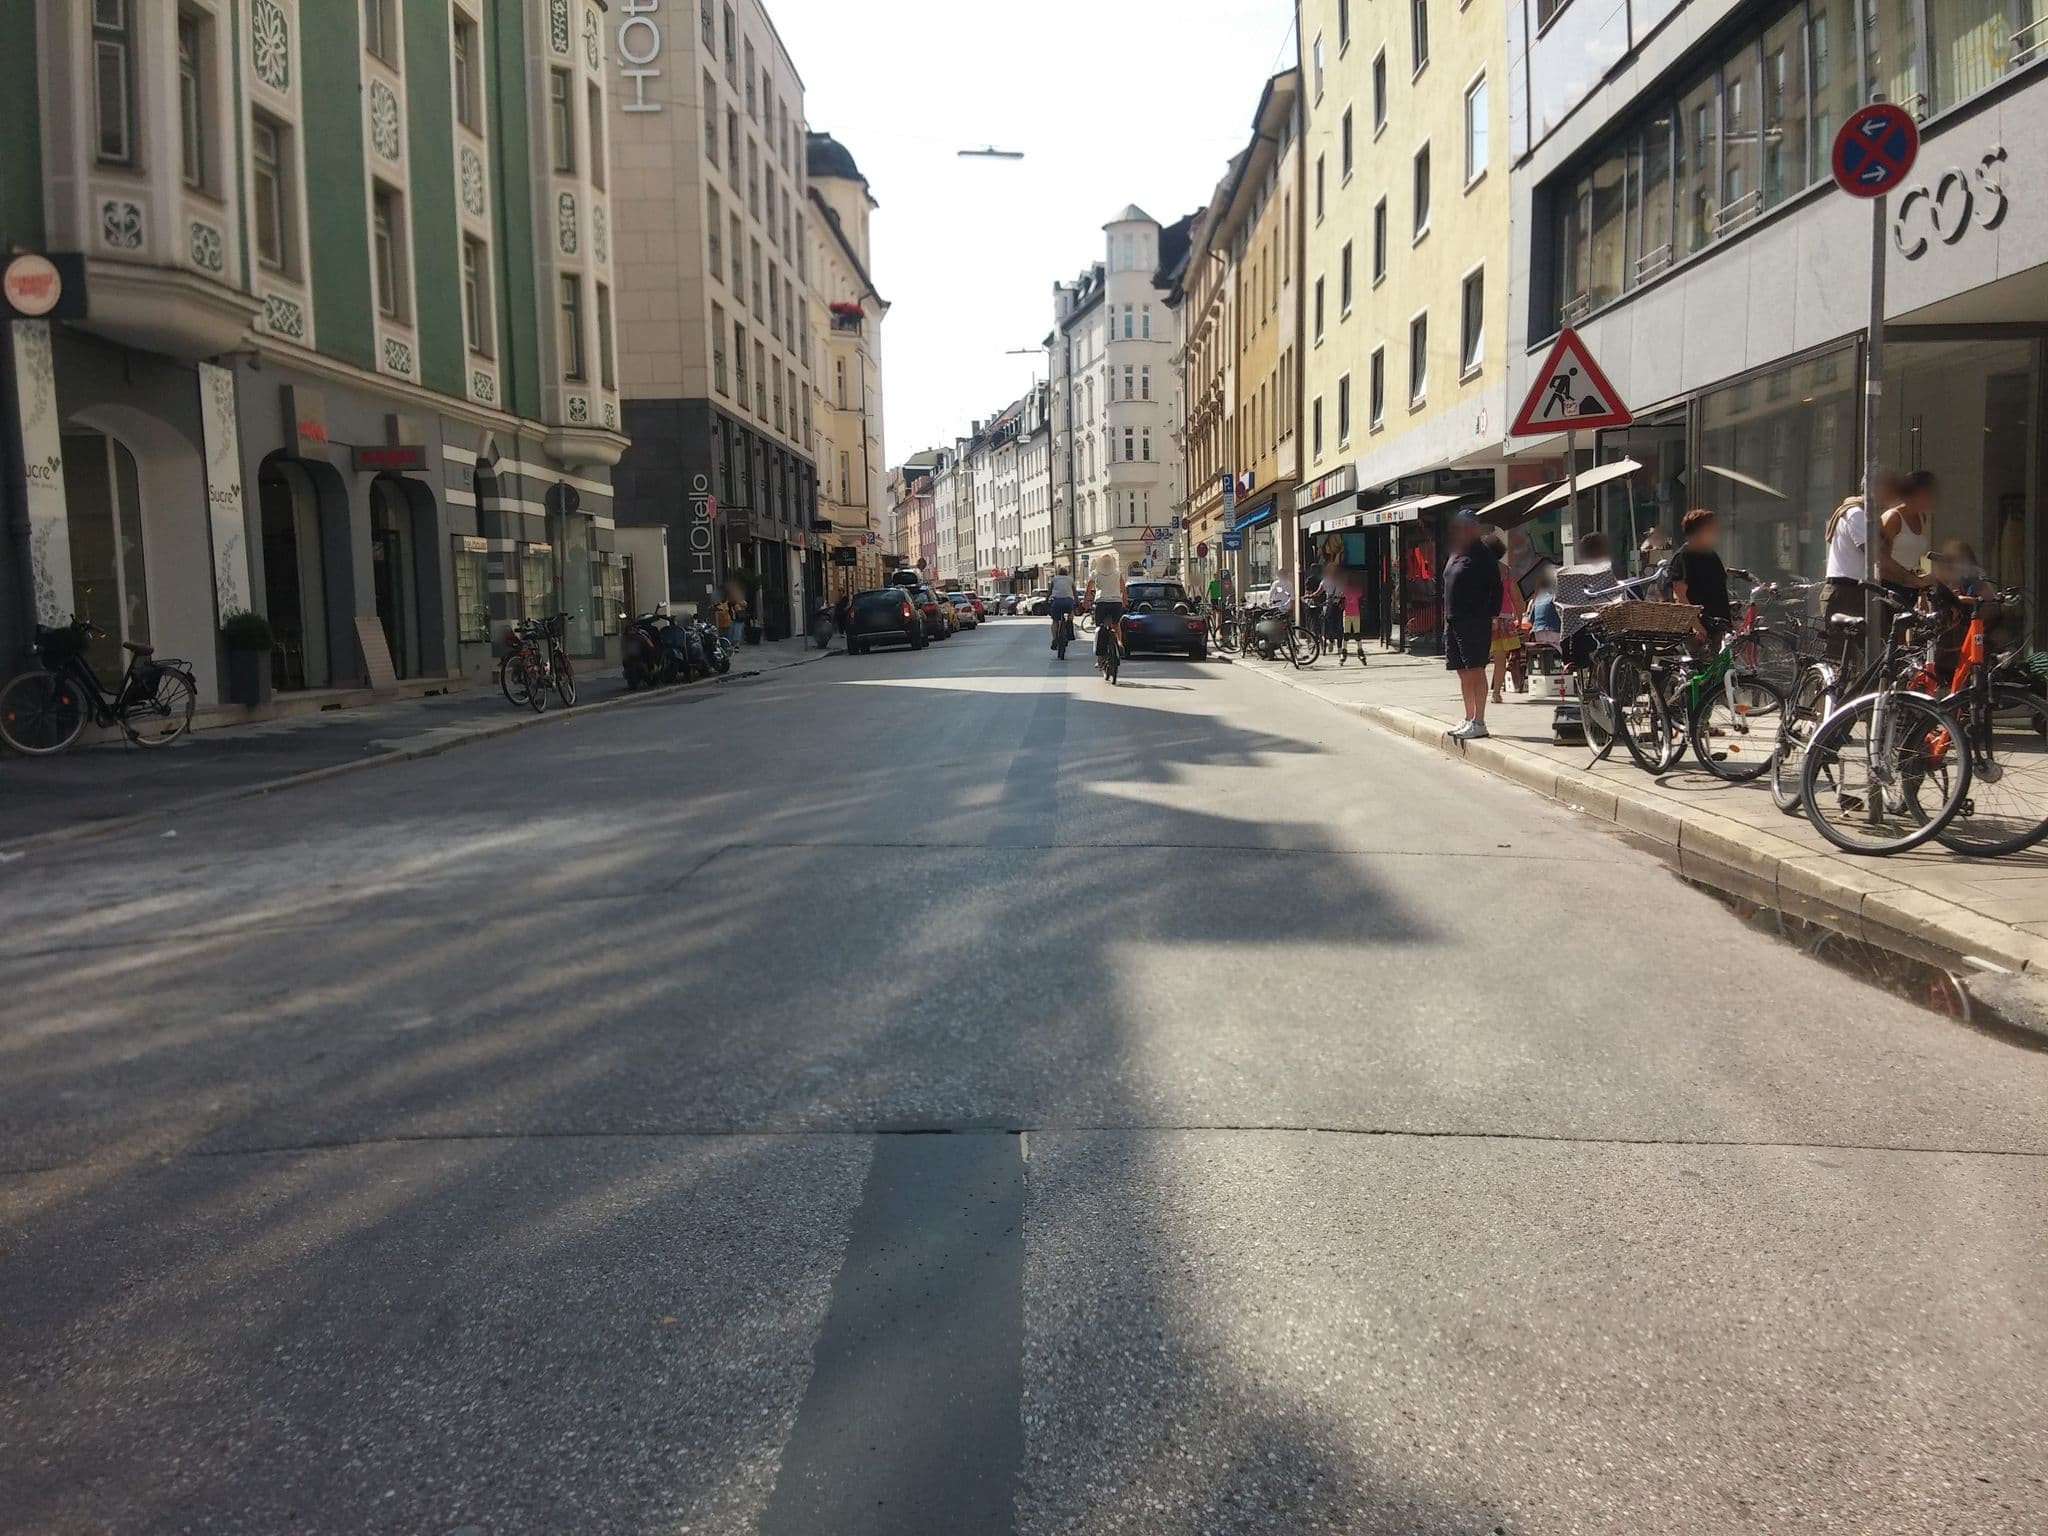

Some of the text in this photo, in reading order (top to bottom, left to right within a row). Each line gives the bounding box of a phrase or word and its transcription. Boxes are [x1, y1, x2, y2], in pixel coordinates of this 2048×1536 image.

[1894, 142, 2008, 261] COS
[24, 464, 50, 480] ucre
[209, 484, 233, 504] Sucre
[1376, 511, 1404, 523] BARTU
